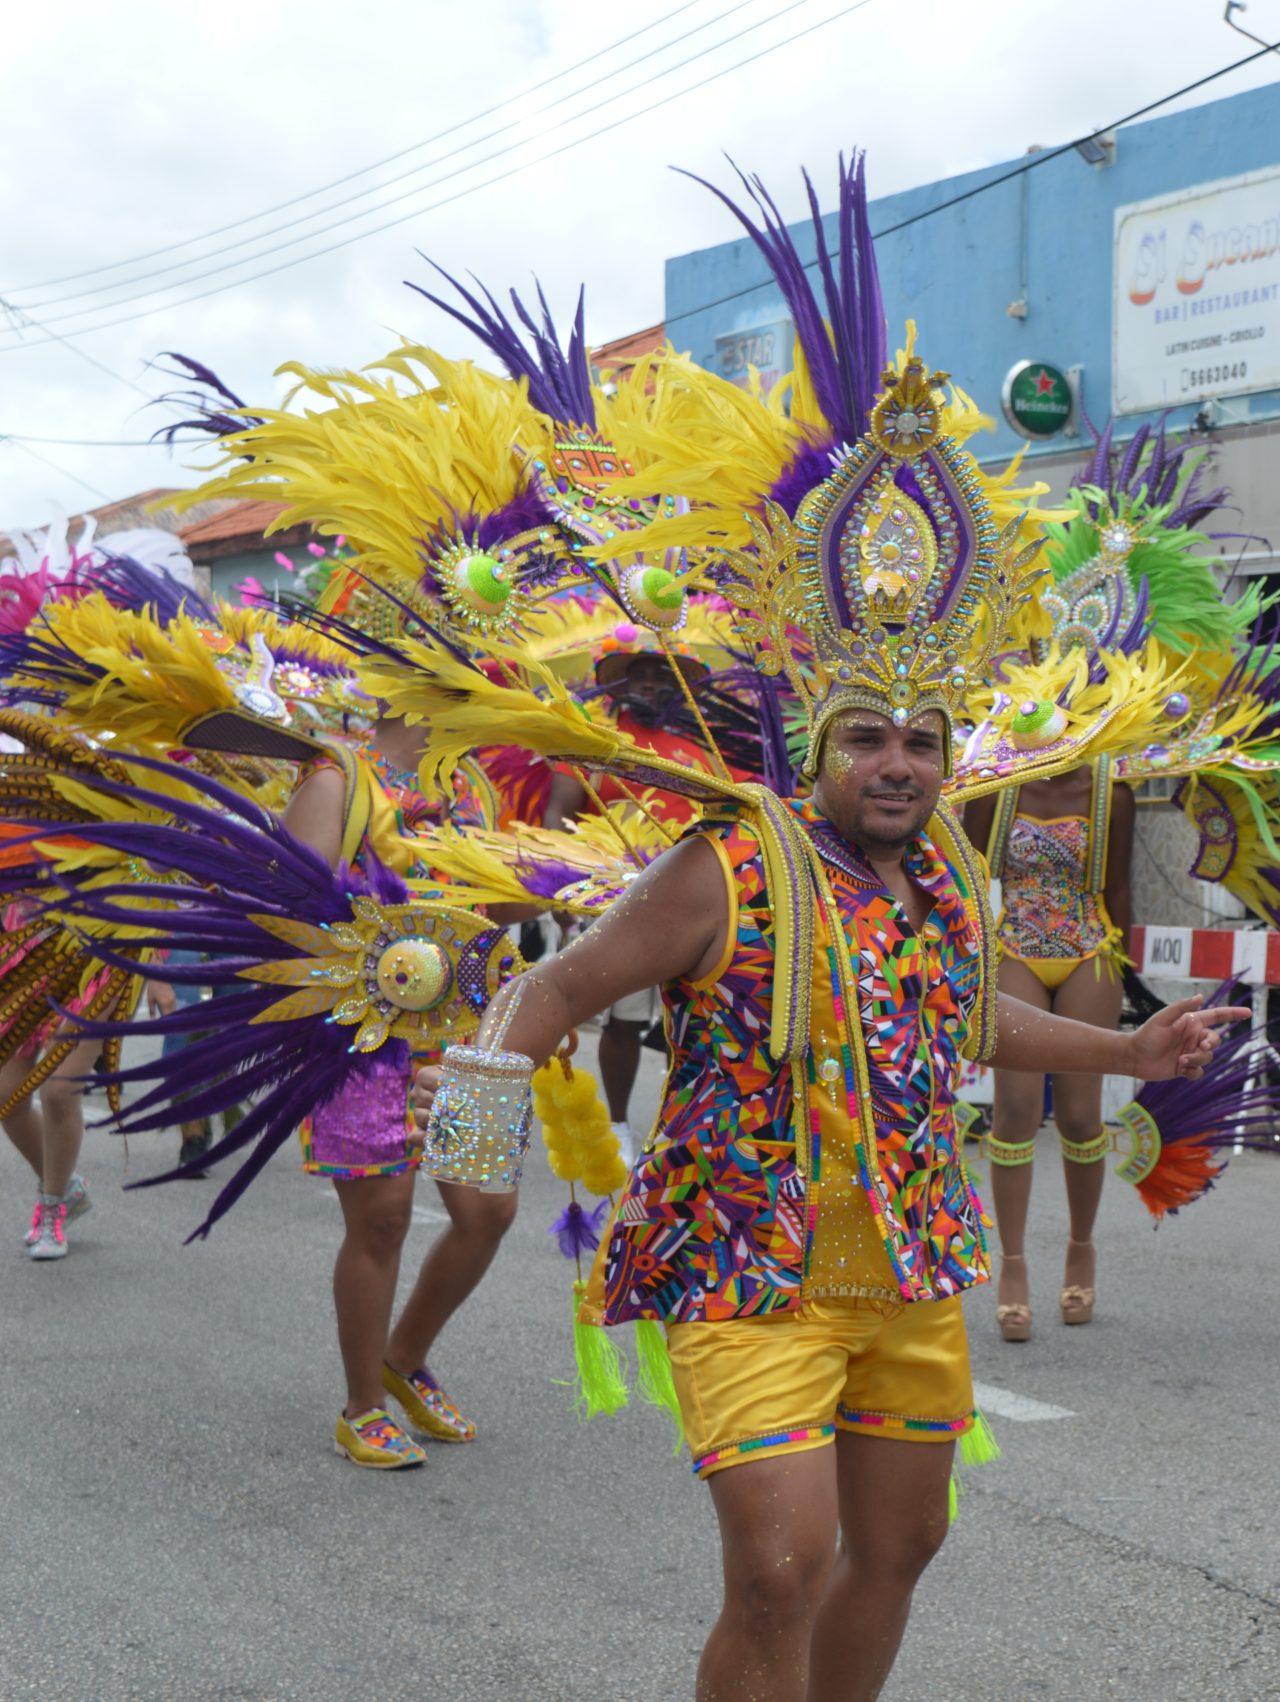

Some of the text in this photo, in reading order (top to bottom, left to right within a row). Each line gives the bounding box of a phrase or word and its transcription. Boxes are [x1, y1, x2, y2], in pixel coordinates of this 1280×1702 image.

[1155, 283, 1278, 325] BAR RESTAURANT
[1165, 341, 1190, 357] LATIN
[1190, 361, 1248, 387] 5663040
[1014, 398, 1069, 415] Heineken
